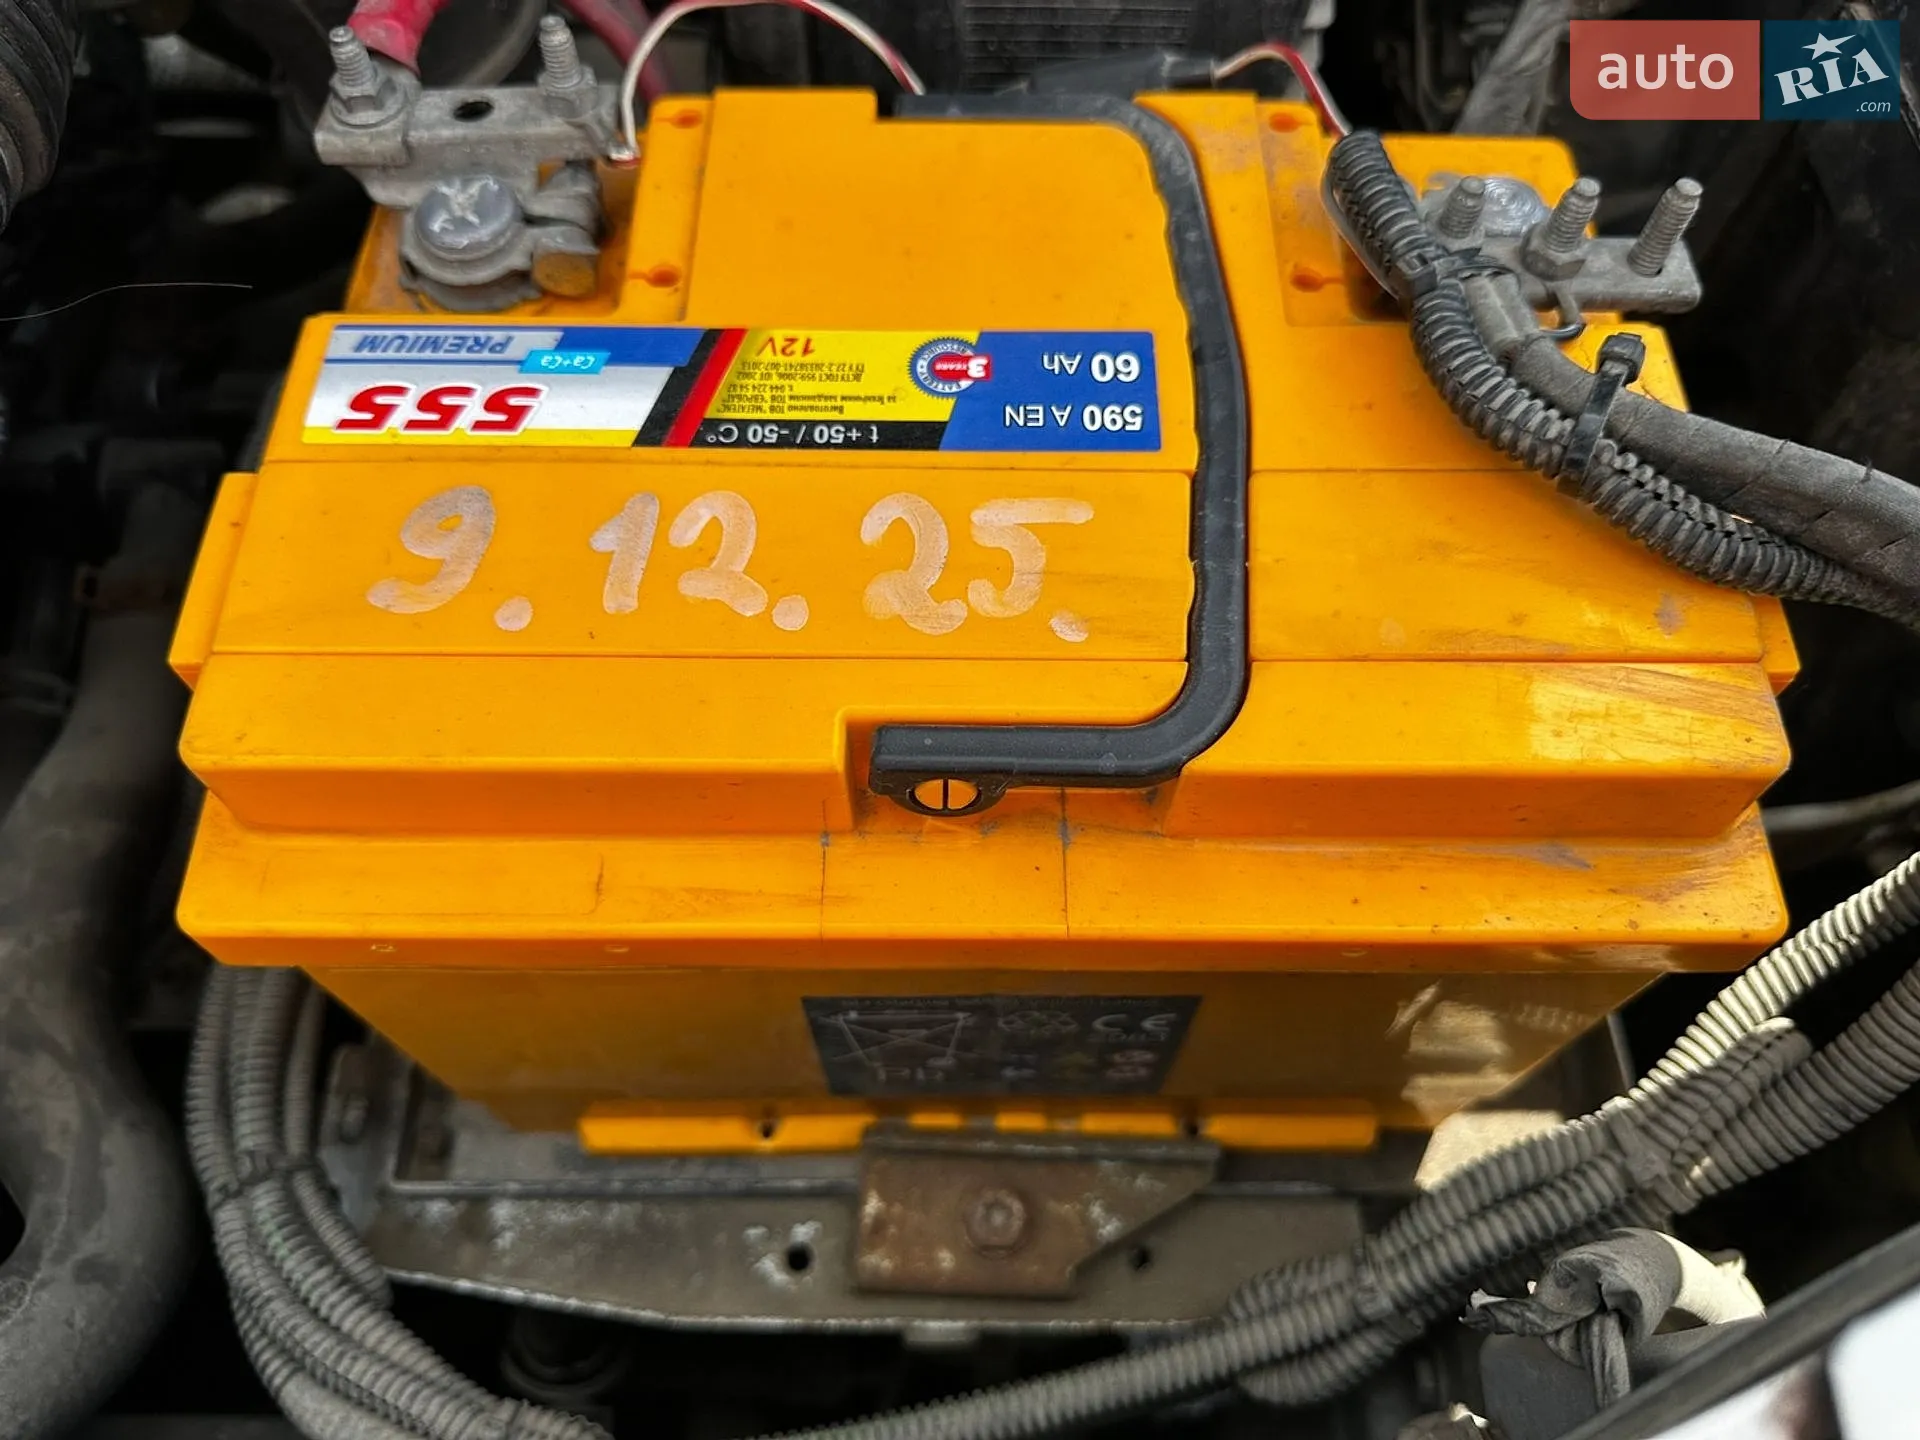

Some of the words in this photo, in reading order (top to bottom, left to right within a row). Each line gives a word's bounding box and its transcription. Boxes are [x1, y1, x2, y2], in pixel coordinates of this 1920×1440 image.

[353, 334, 515, 354] PREMIUM
[756, 337, 815, 357] 12V
[540, 353, 596, 369] Ca+Ca
[967, 356, 988, 378] 3
[1042, 352, 1082, 375] Ah
[1090, 353, 1141, 382] 60
[334, 384, 547, 432] 555
[1005, 405, 1044, 427] EN
[1051, 405, 1072, 426] A
[1082, 405, 1143, 431] 590
[747, 424, 789, 444] -50
[796, 424, 807, 444] /
[813, 424, 862, 444] +50
[869, 426, 879, 444] t
